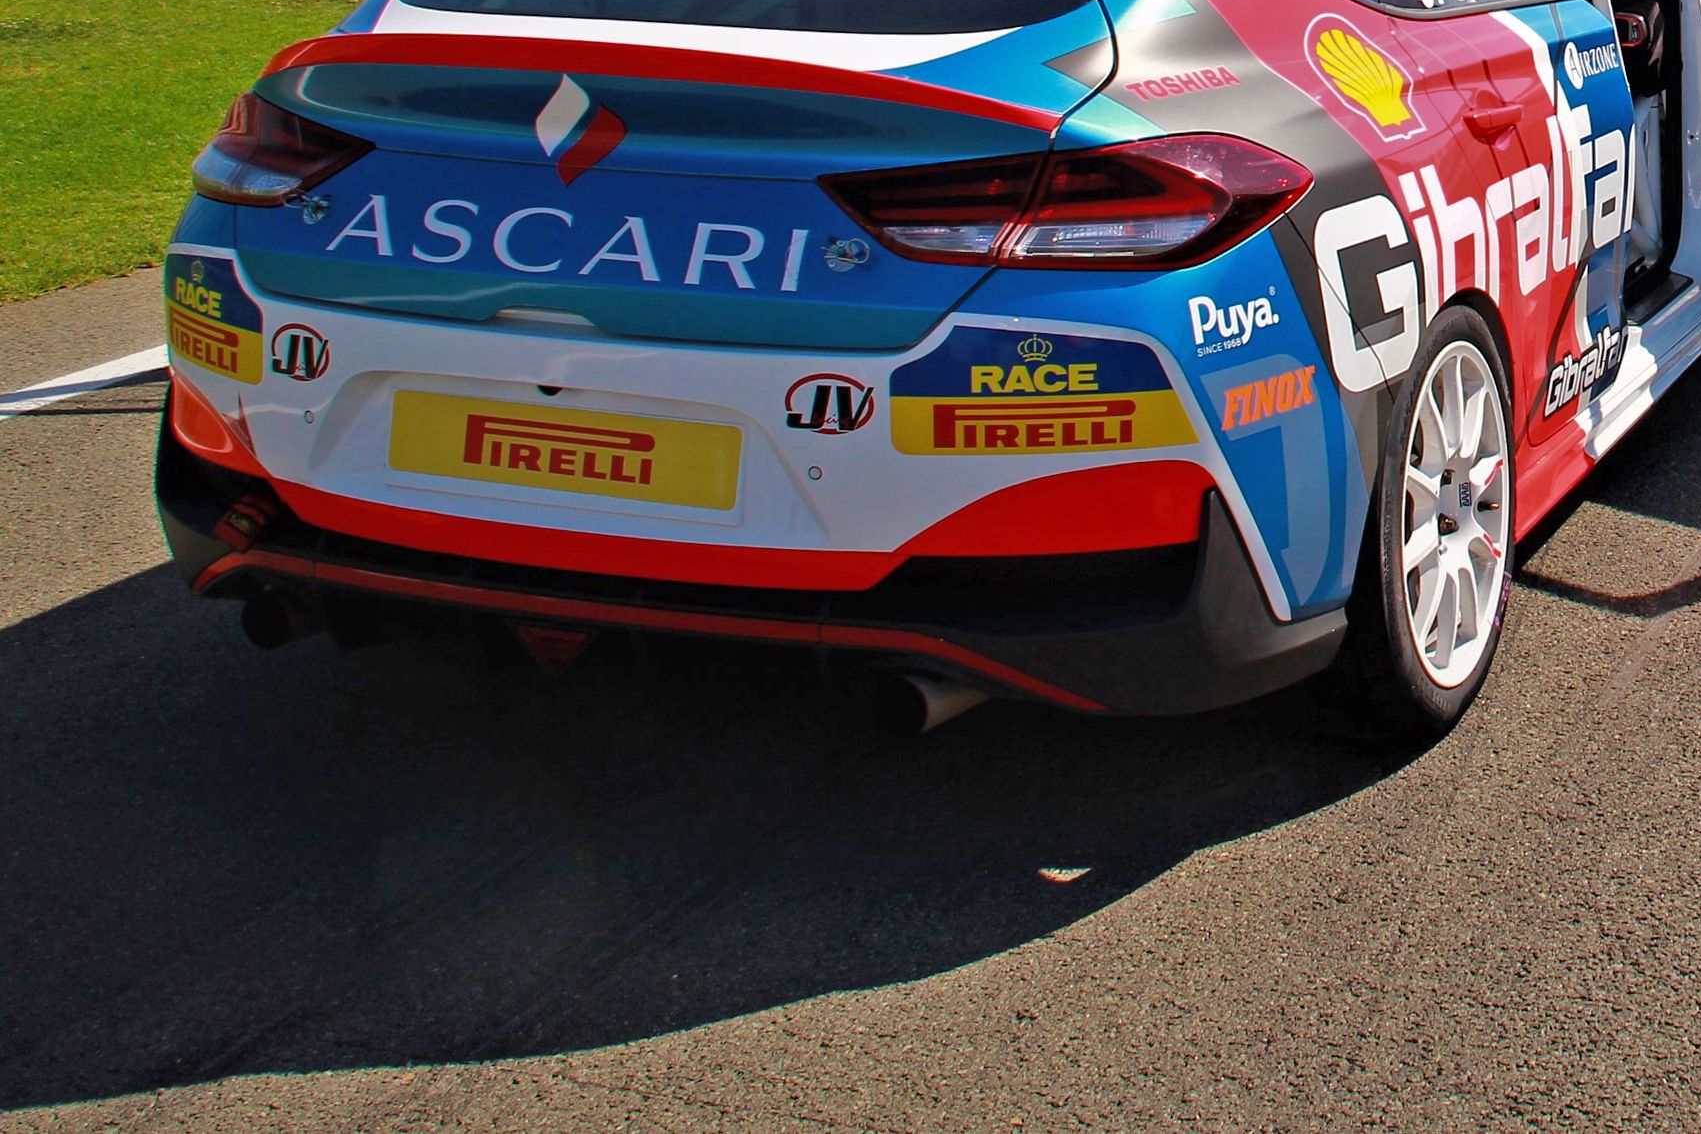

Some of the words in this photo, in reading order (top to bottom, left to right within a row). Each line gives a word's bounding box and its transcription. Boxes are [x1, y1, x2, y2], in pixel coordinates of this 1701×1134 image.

[1124, 65, 1241, 102] TOSHIBA
[1565, 43, 1619, 85] AIRZONE
[325, 193, 809, 293] ASCARI
[175, 277, 223, 318] RACE
[169, 305, 240, 374] PIRELLI
[1197, 342, 1223, 357] SINCE
[969, 363, 1100, 394] RACE
[1221, 365, 1316, 431] FINOX
[932, 399, 1137, 449] PIRELLI
[462, 414, 656, 487] PIRELLI
